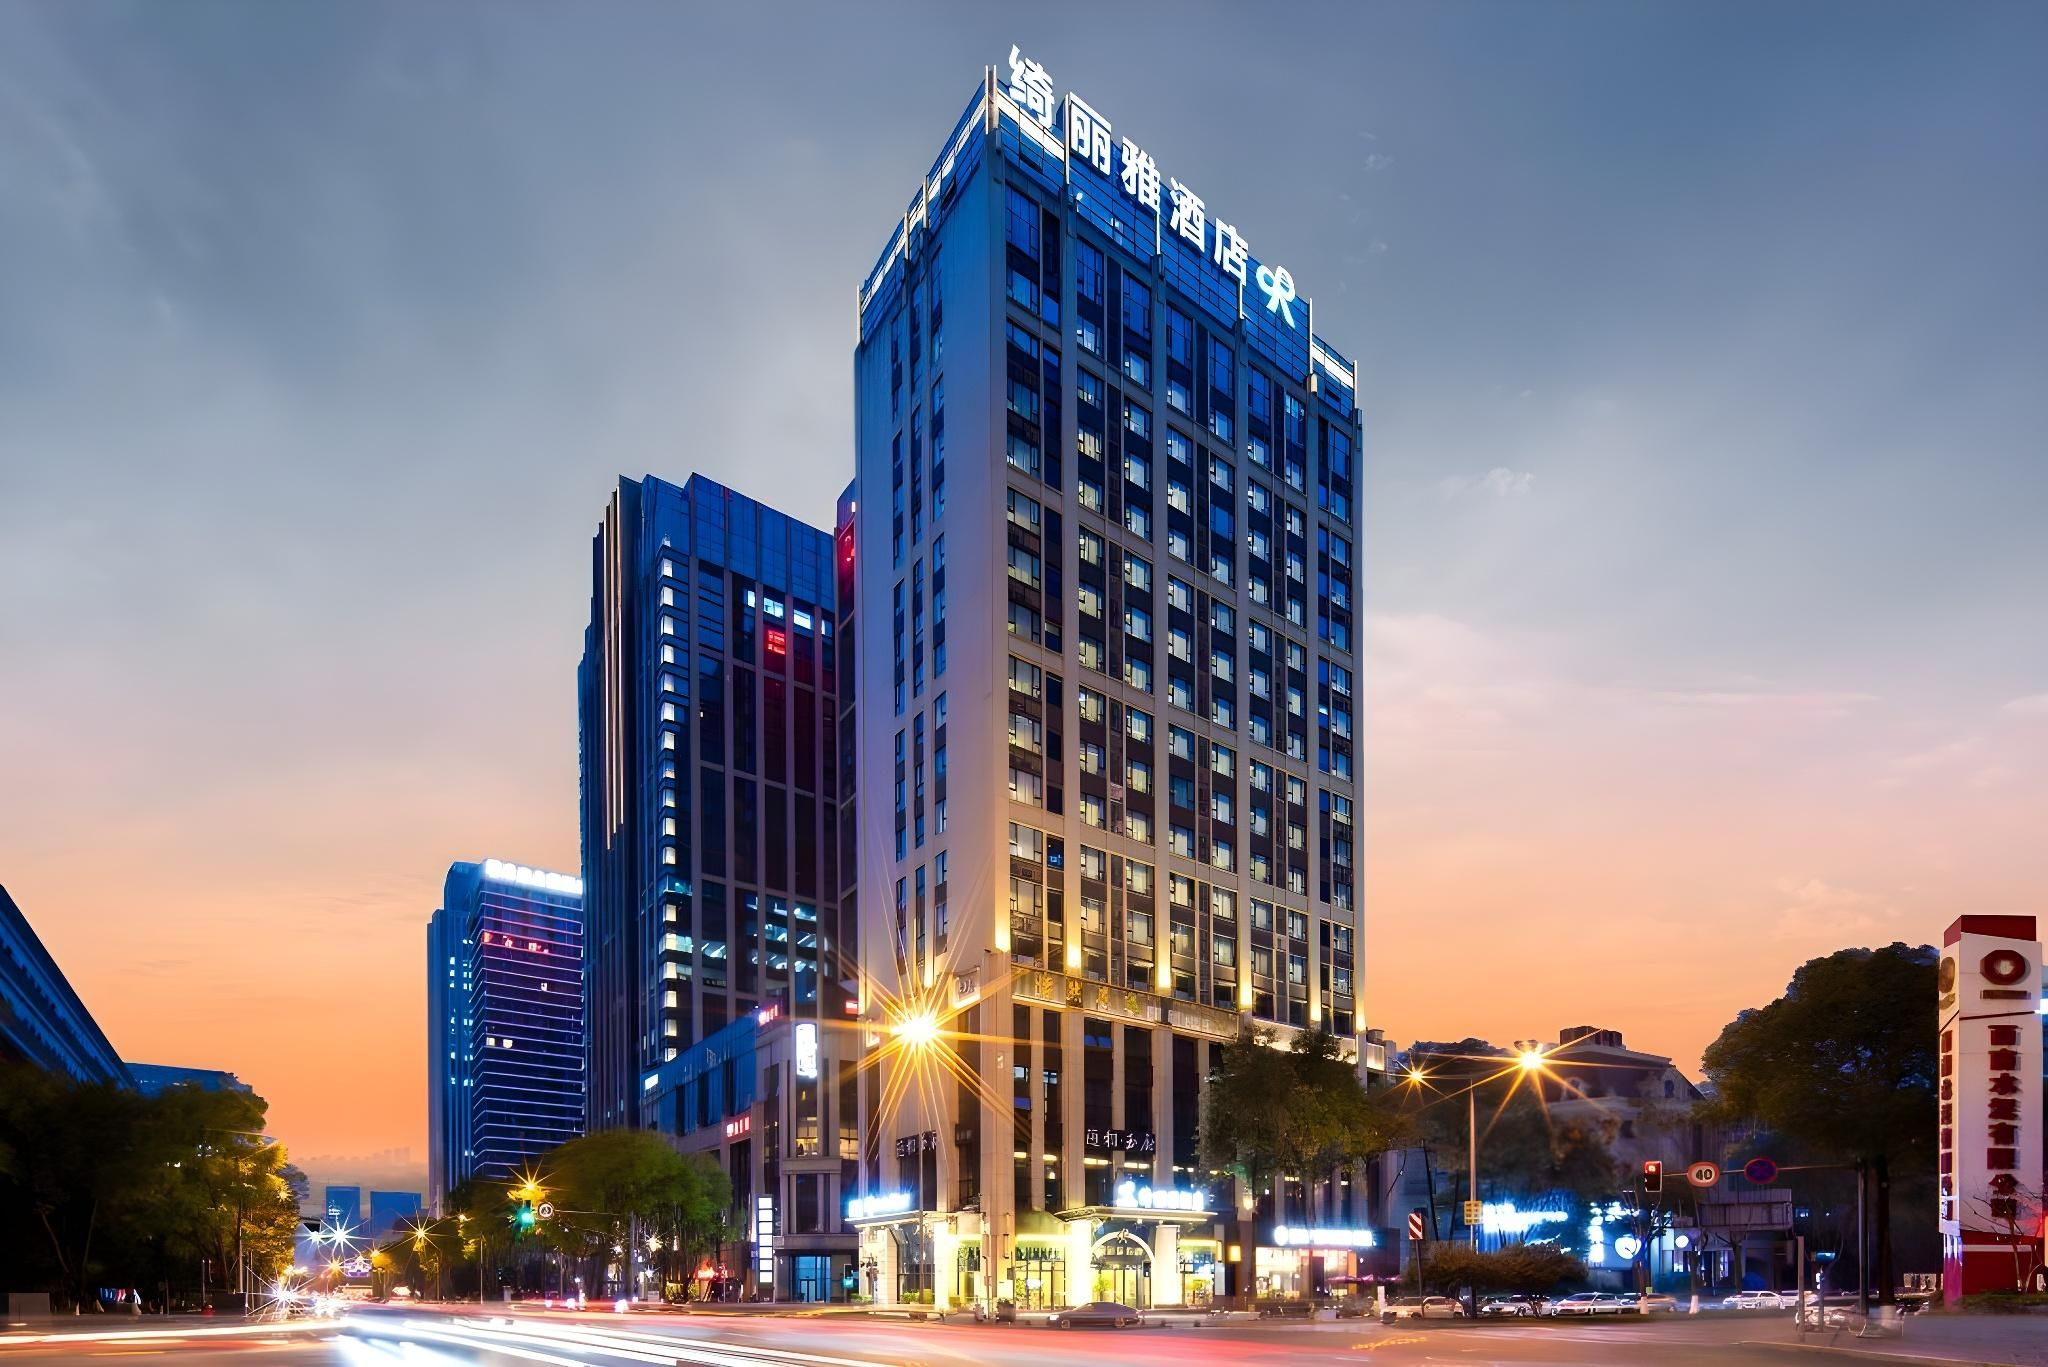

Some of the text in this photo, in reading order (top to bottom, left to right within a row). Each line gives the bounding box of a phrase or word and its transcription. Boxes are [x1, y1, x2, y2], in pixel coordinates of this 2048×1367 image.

[1009, 44, 1247, 286] 绮丽雅酒店
[1696, 1168, 1713, 1180] 40
